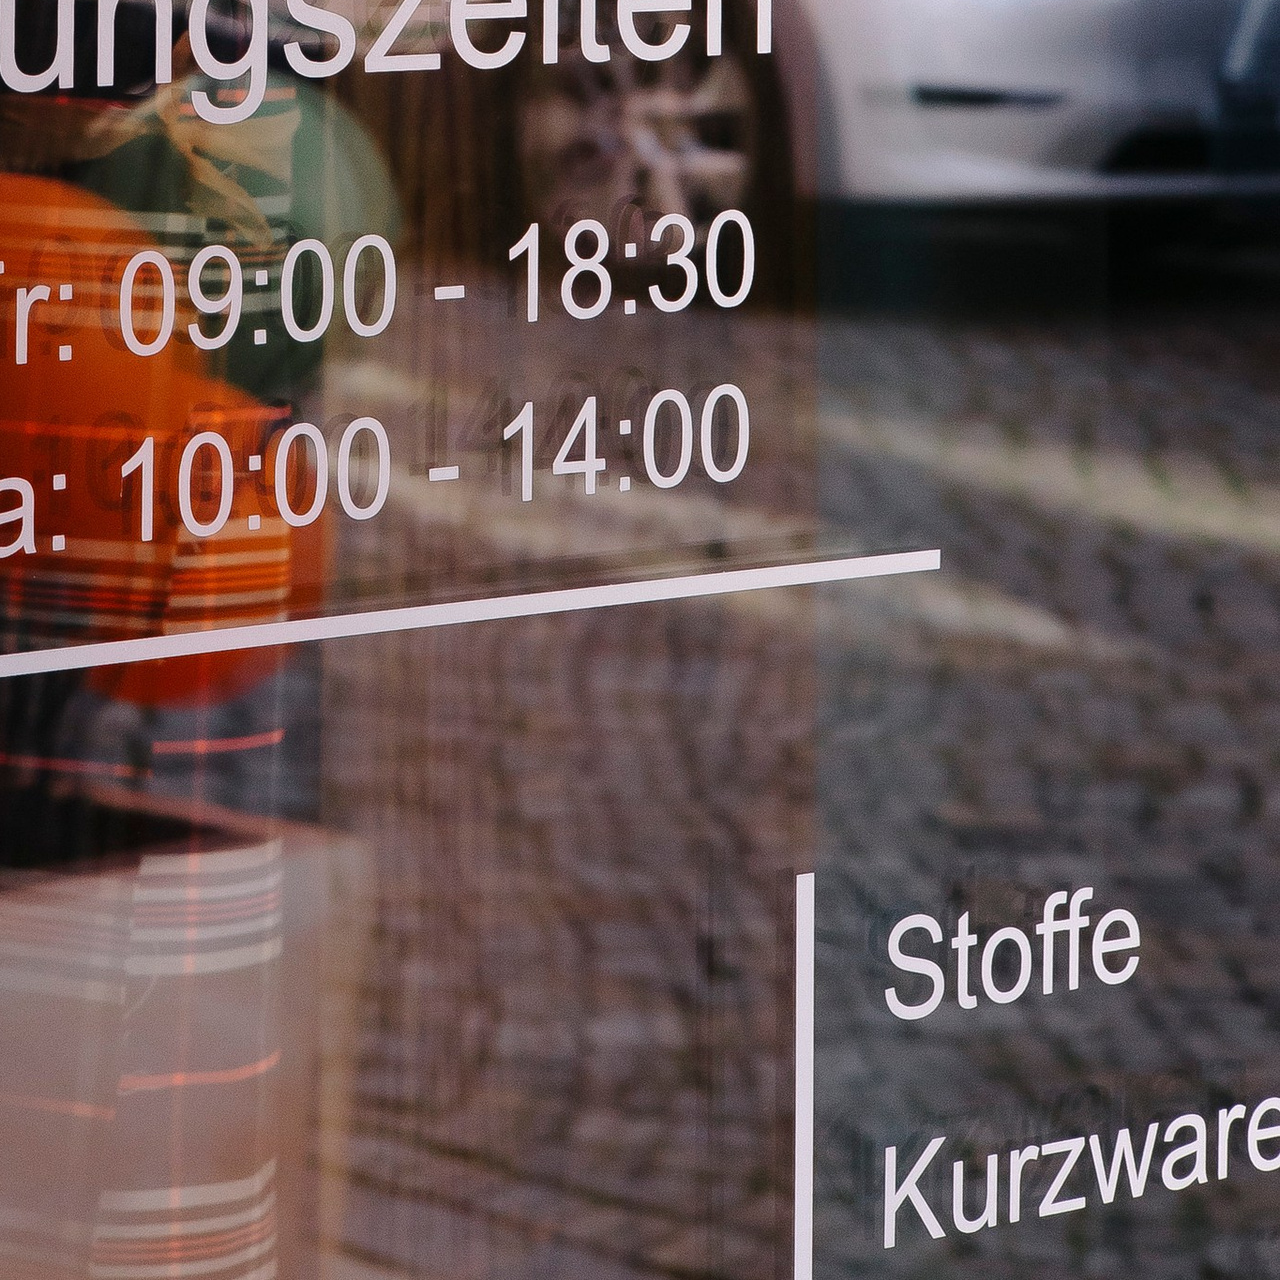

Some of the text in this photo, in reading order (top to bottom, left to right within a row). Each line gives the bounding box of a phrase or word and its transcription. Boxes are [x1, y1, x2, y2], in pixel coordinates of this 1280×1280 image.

[117, 233, 398, 358] 09:00
[506, 208, 757, 324] 18:30
[119, 416, 392, 543] 10:00
[501, 383, 751, 503] 14:00
[883, 886, 1142, 1021] Stoffe
